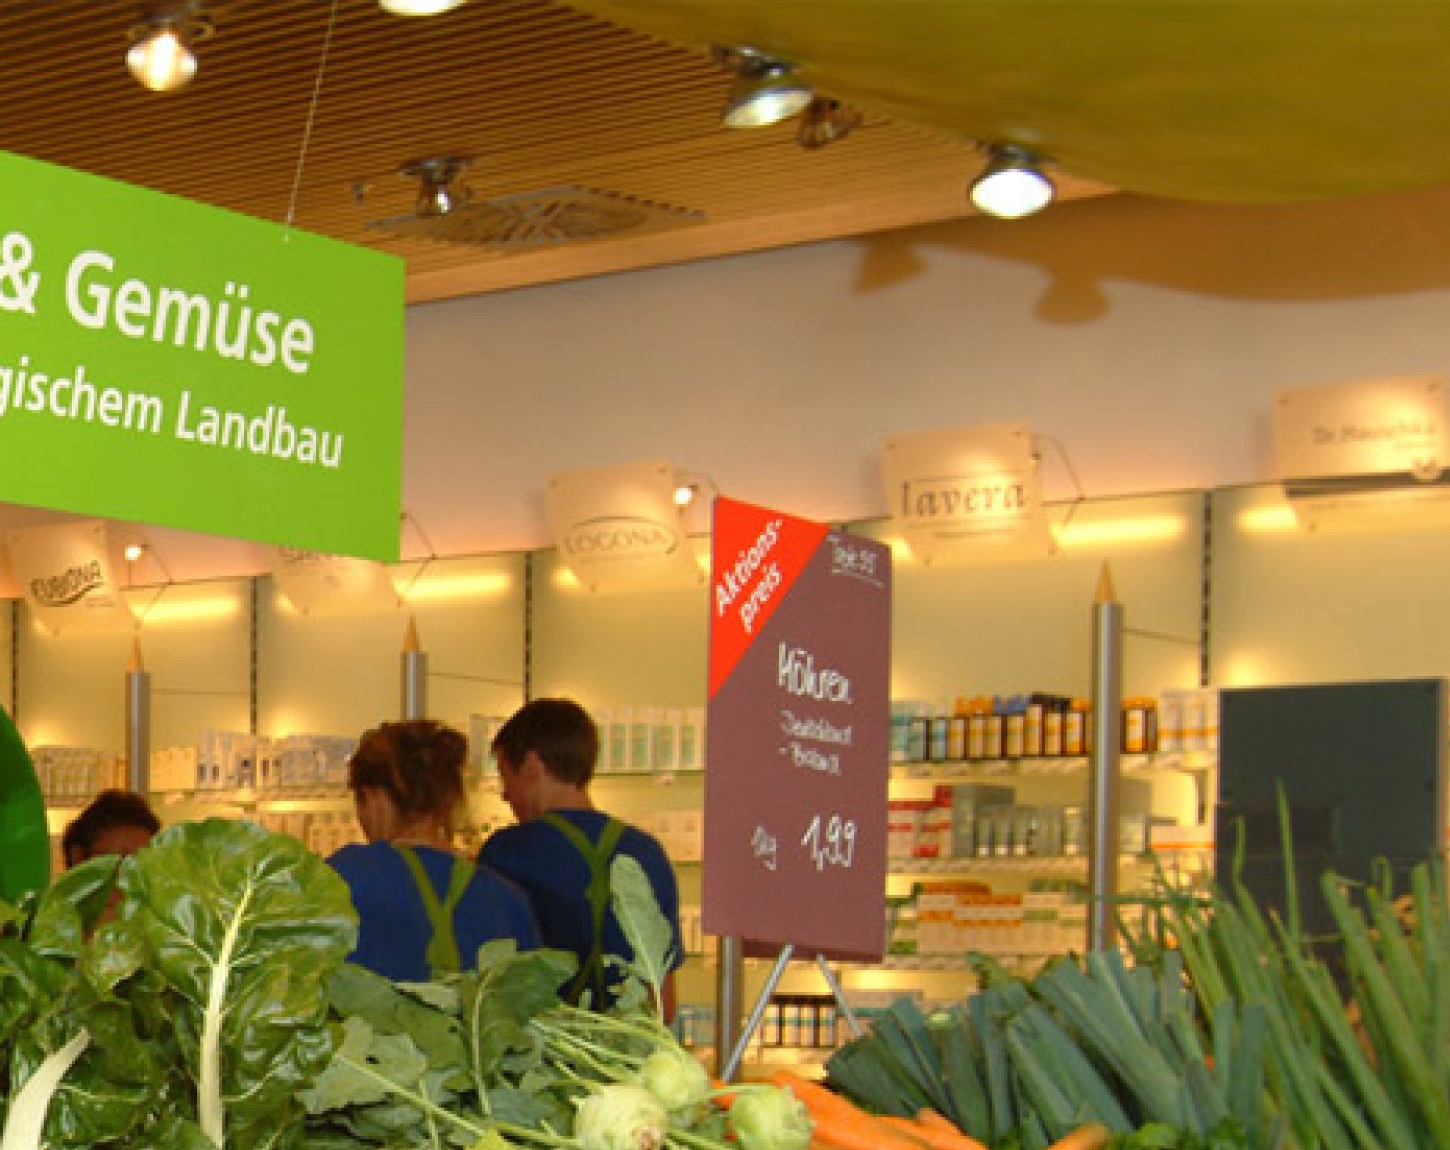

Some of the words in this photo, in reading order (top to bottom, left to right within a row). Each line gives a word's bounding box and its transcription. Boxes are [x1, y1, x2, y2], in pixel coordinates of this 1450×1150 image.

[64, 249, 316, 375] Gemüse
[176, 392, 344, 469] Landbau
[900, 480, 1027, 518] lavera
[715, 518, 784, 618] Aktions-
[739, 562, 783, 636] preis
